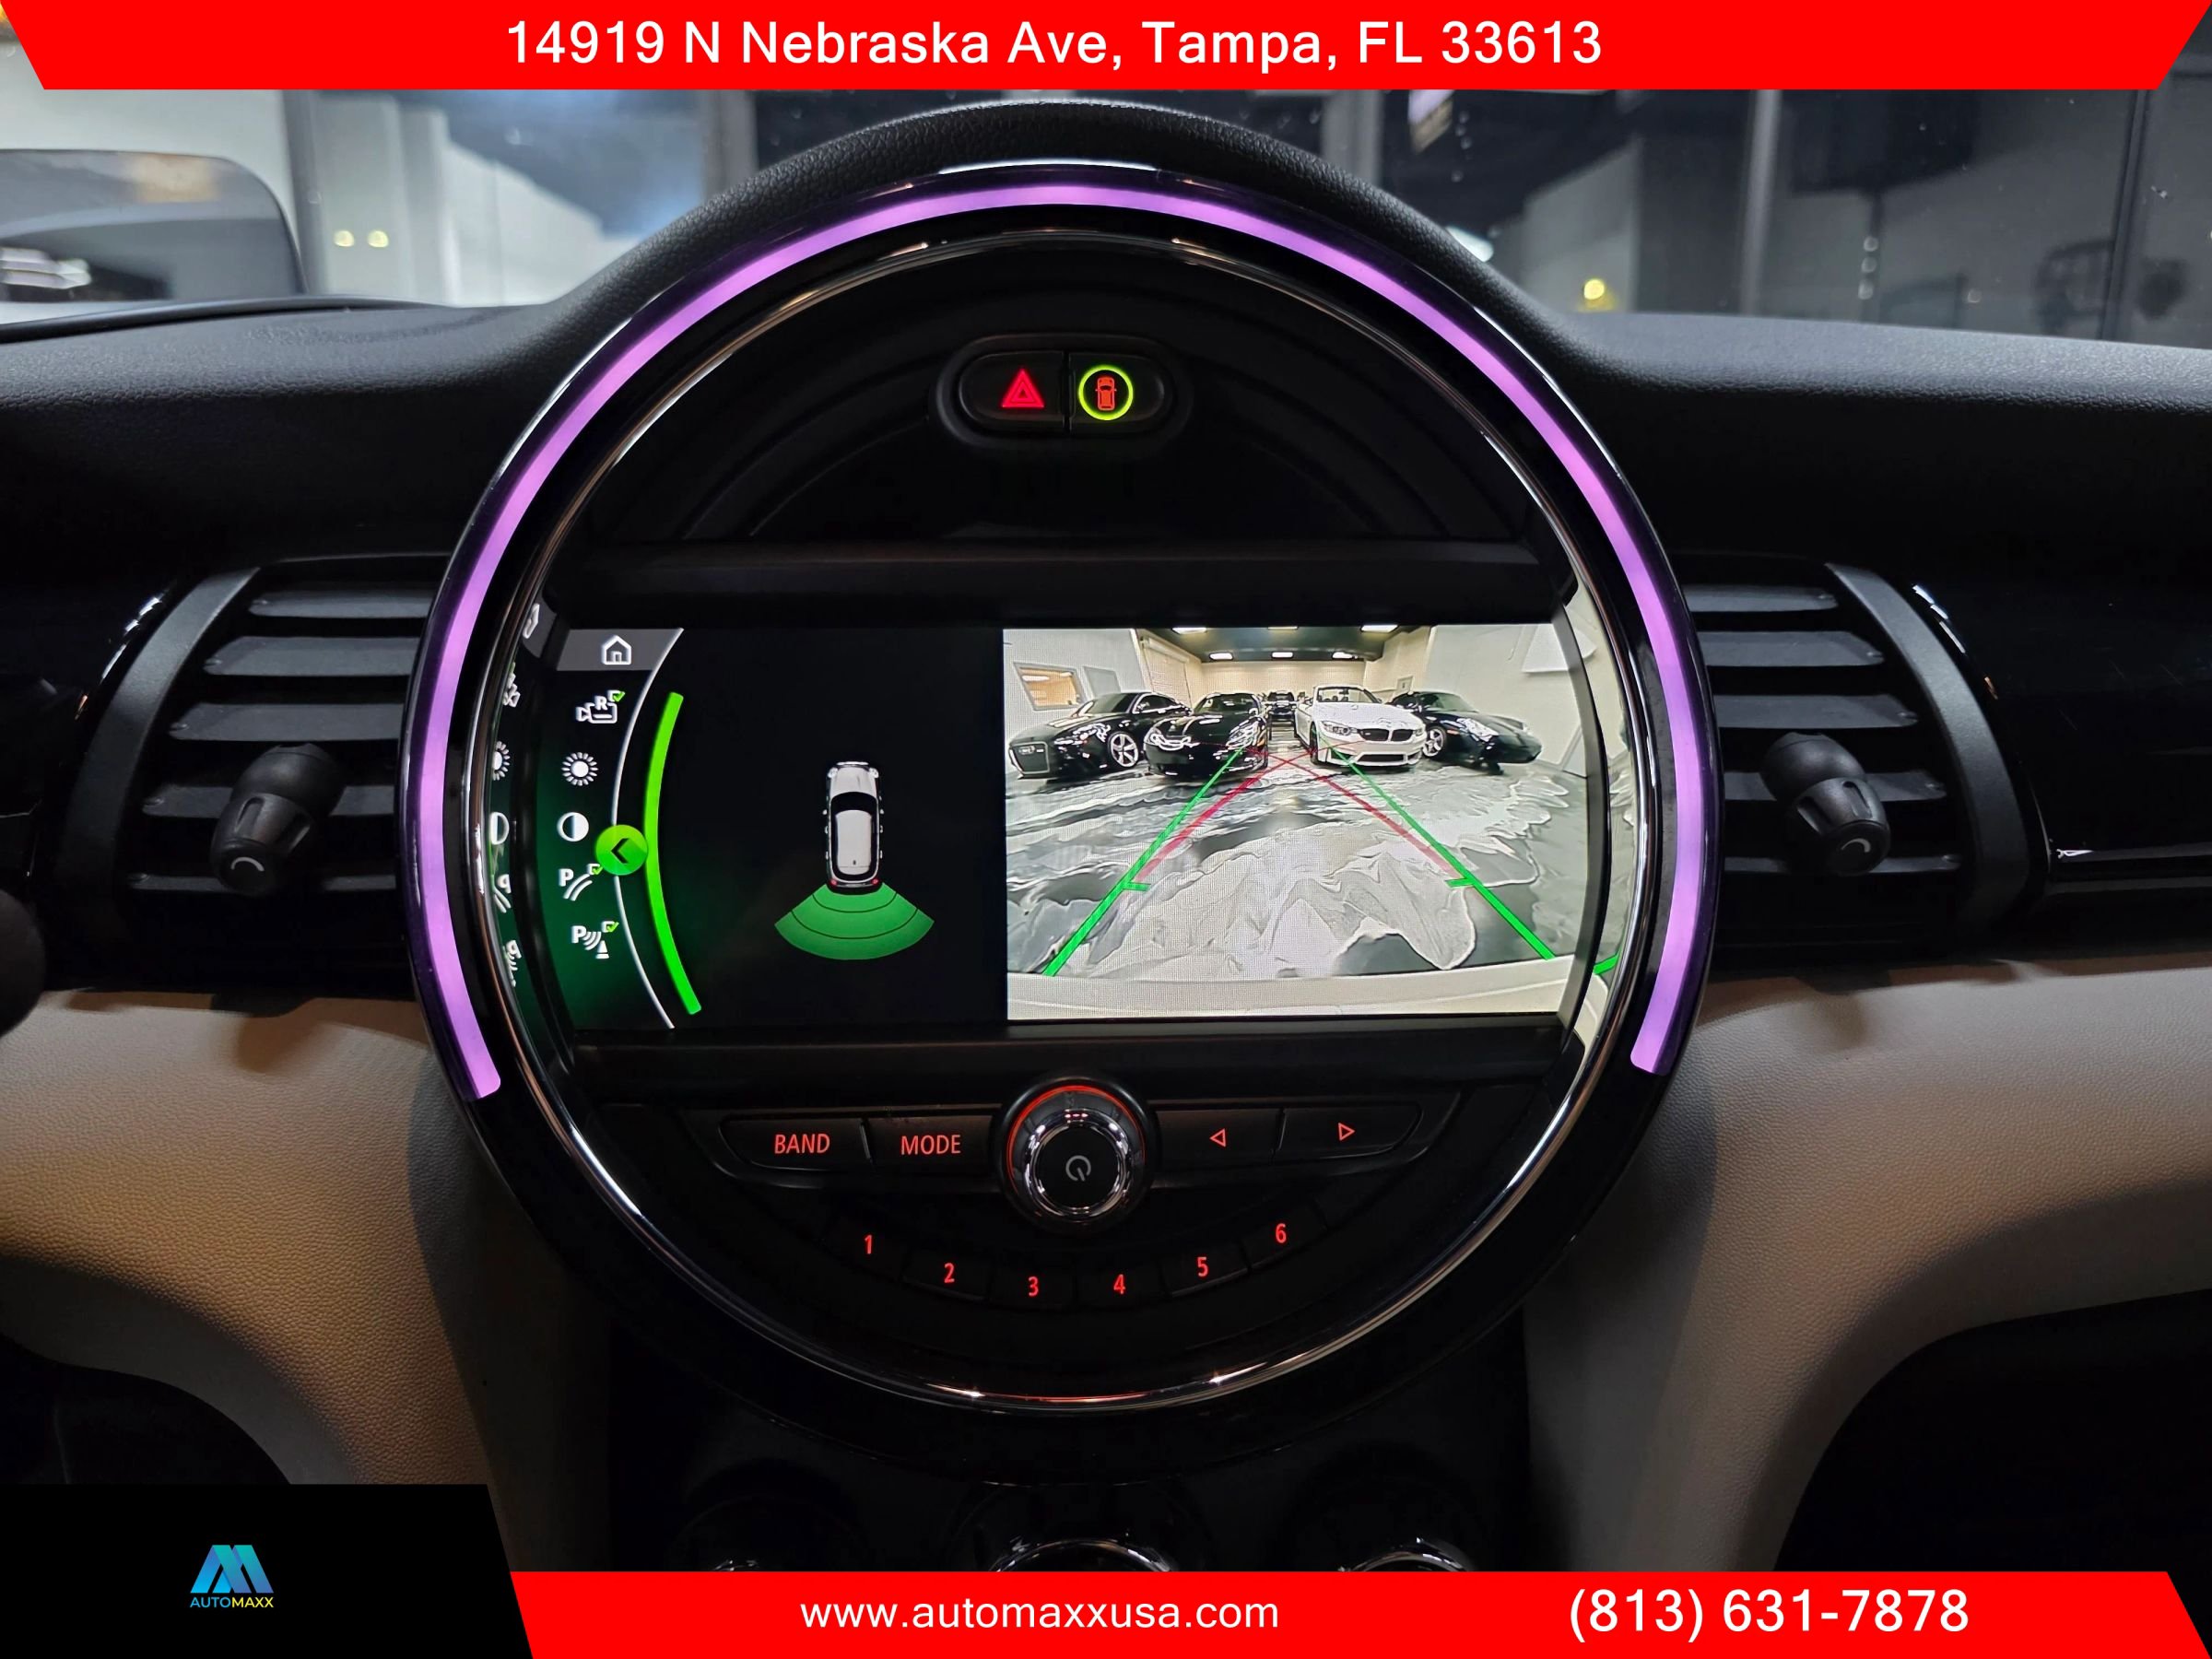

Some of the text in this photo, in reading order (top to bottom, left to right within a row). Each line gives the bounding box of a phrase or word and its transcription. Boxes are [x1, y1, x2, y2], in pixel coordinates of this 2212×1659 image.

[773, 1133, 831, 1155] BAND
[900, 1134, 961, 1156] MODE
[864, 1234, 874, 1254] 1
[1274, 1222, 1288, 1244] 6
[942, 1262, 956, 1284] 2
[1195, 1255, 1209, 1277] 5
[1026, 1275, 1040, 1298] 3
[1112, 1273, 1127, 1296] 4
